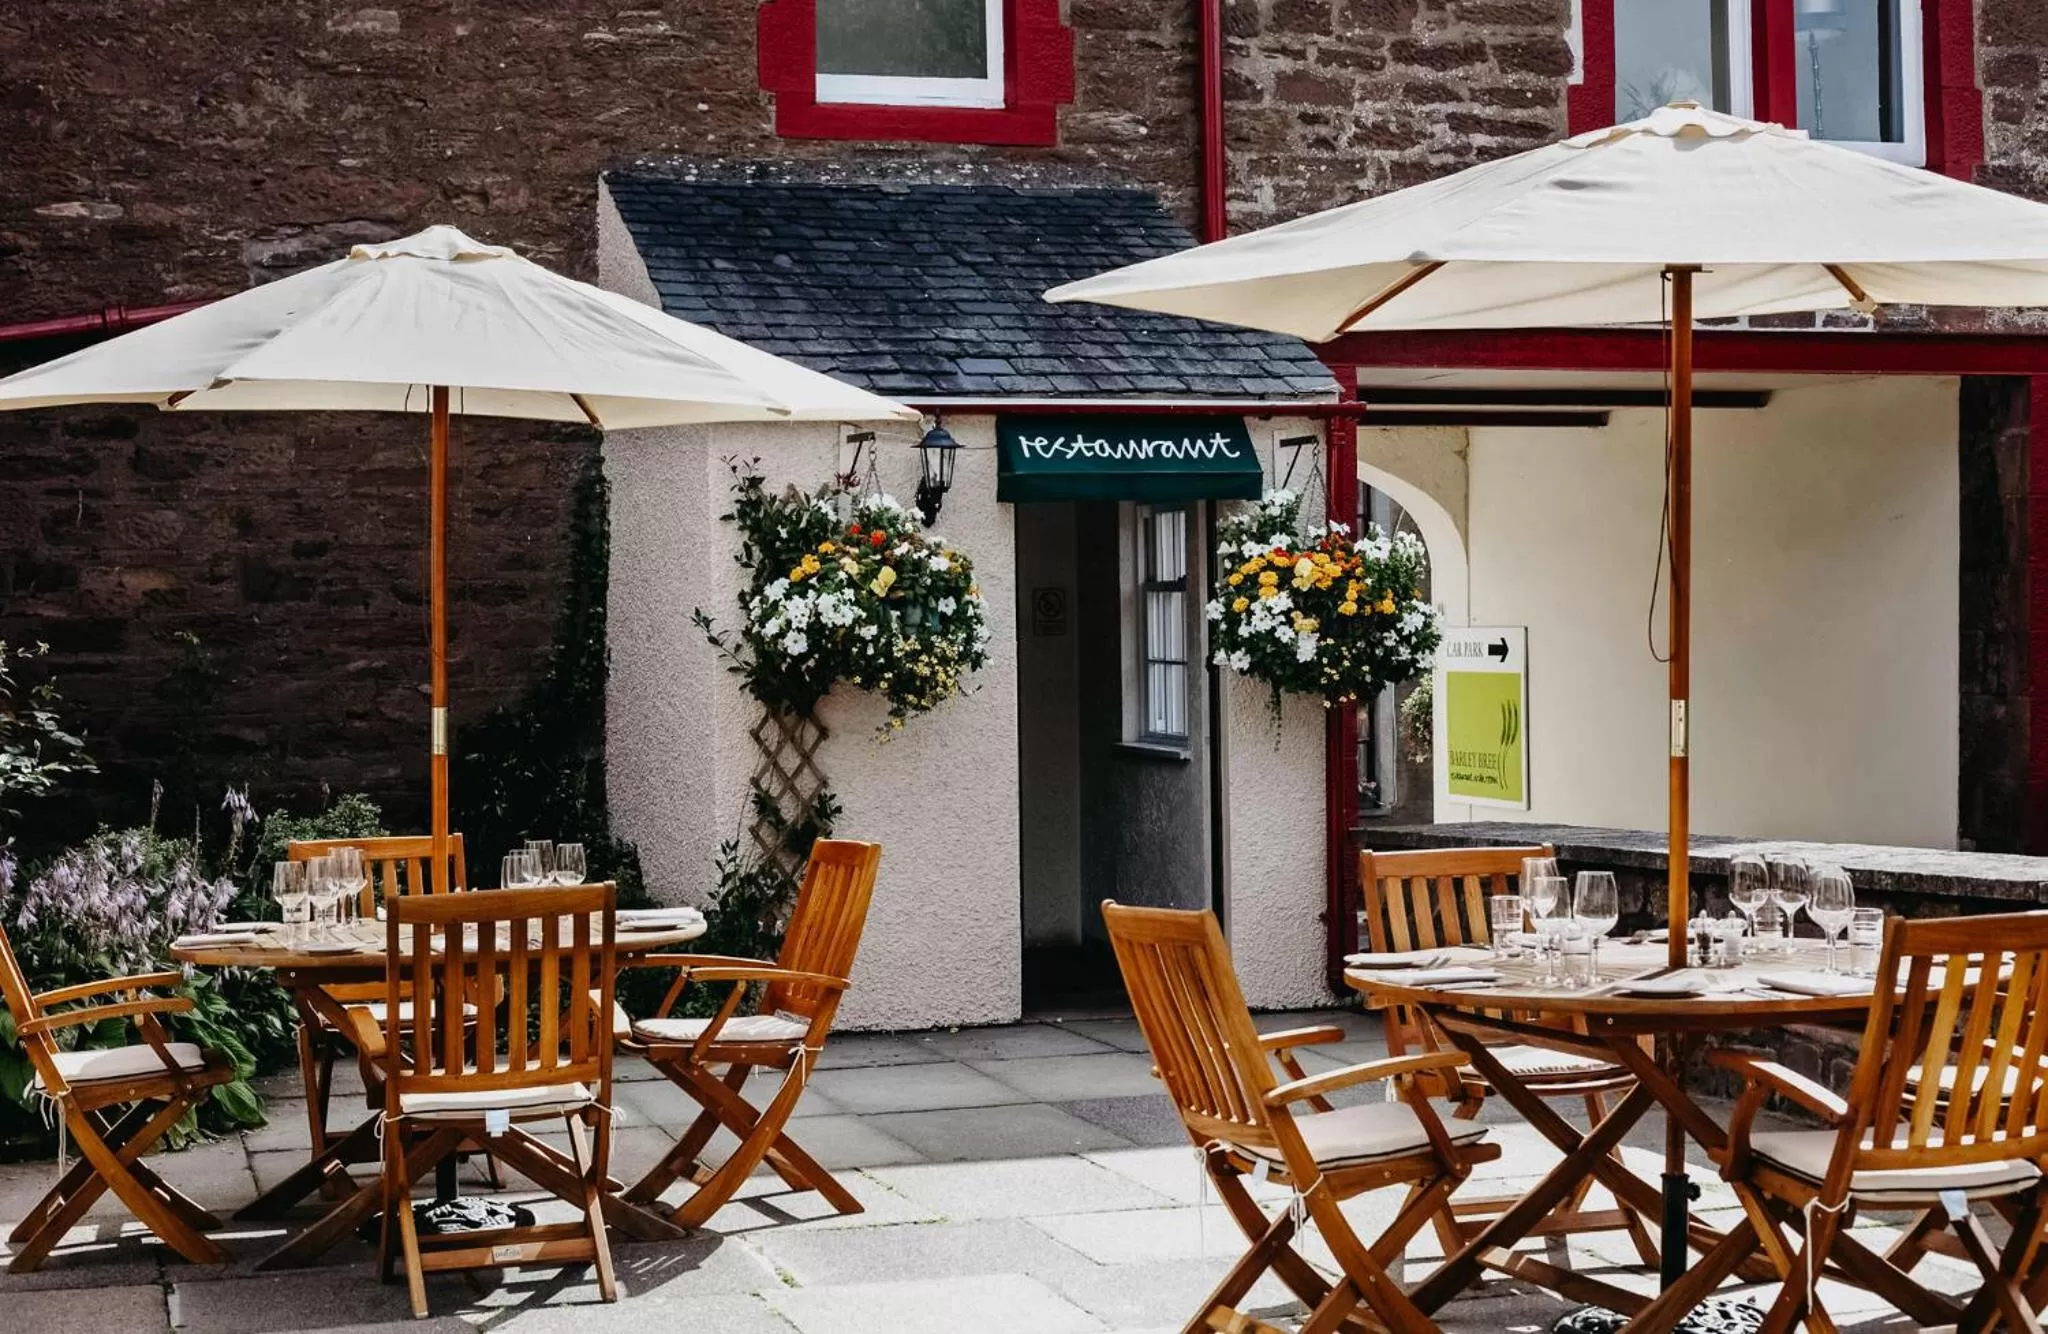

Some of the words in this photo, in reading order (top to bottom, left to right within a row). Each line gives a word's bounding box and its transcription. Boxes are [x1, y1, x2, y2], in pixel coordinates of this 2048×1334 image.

[1018, 432, 1240, 459] restaurant
[1446, 641, 1461, 657] CAR
[1464, 641, 1484, 658] PARK
